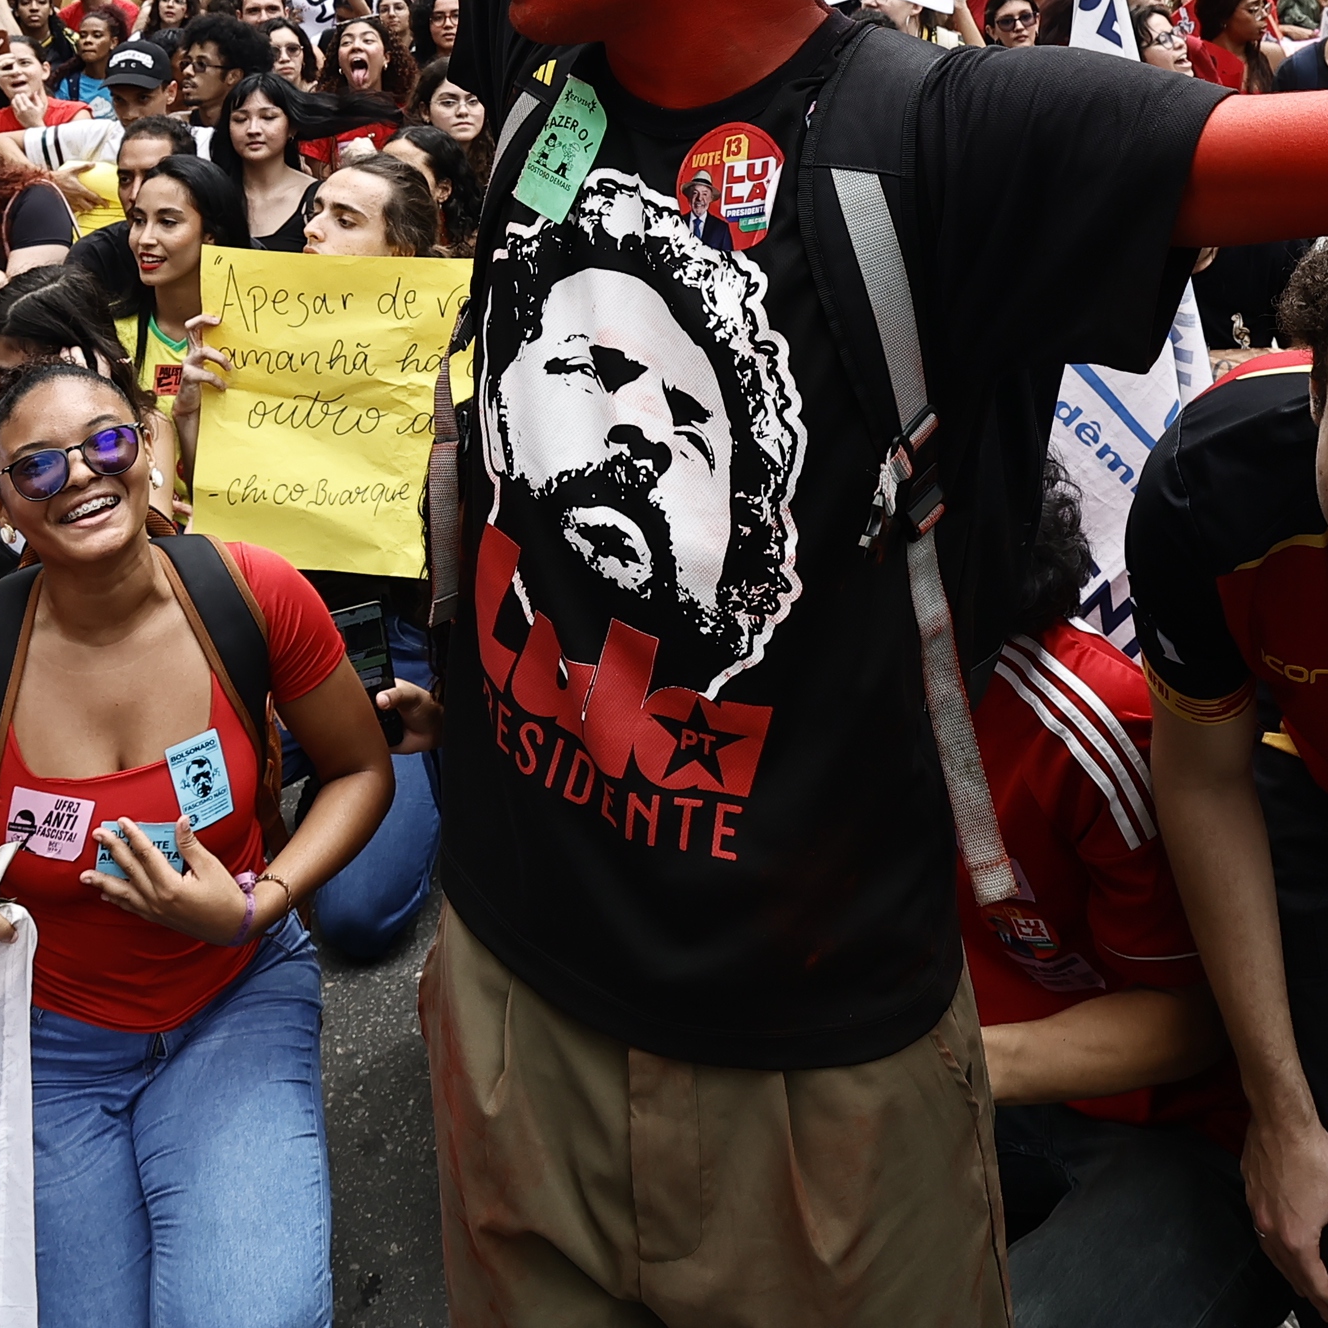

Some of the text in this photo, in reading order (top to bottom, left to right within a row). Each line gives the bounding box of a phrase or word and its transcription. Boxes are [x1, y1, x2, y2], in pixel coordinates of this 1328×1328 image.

[544, 115, 594, 154] FAZER O L
[692, 137, 743, 168] VOTE 13
[527, 163, 572, 192] GOSTOSO DEMAIS
[377, 277, 422, 320] de
[219, 339, 378, 376] amanhã
[248, 391, 389, 436] outro
[170, 739, 216, 764] BOLSONARO
[680, 728, 716, 756] PT
[54, 798, 82, 814] UFRJ
[183, 793, 213, 813] FASCISMO
[35, 825, 77, 843] FASCISTA!
[41, 810, 80, 832] ANTI
